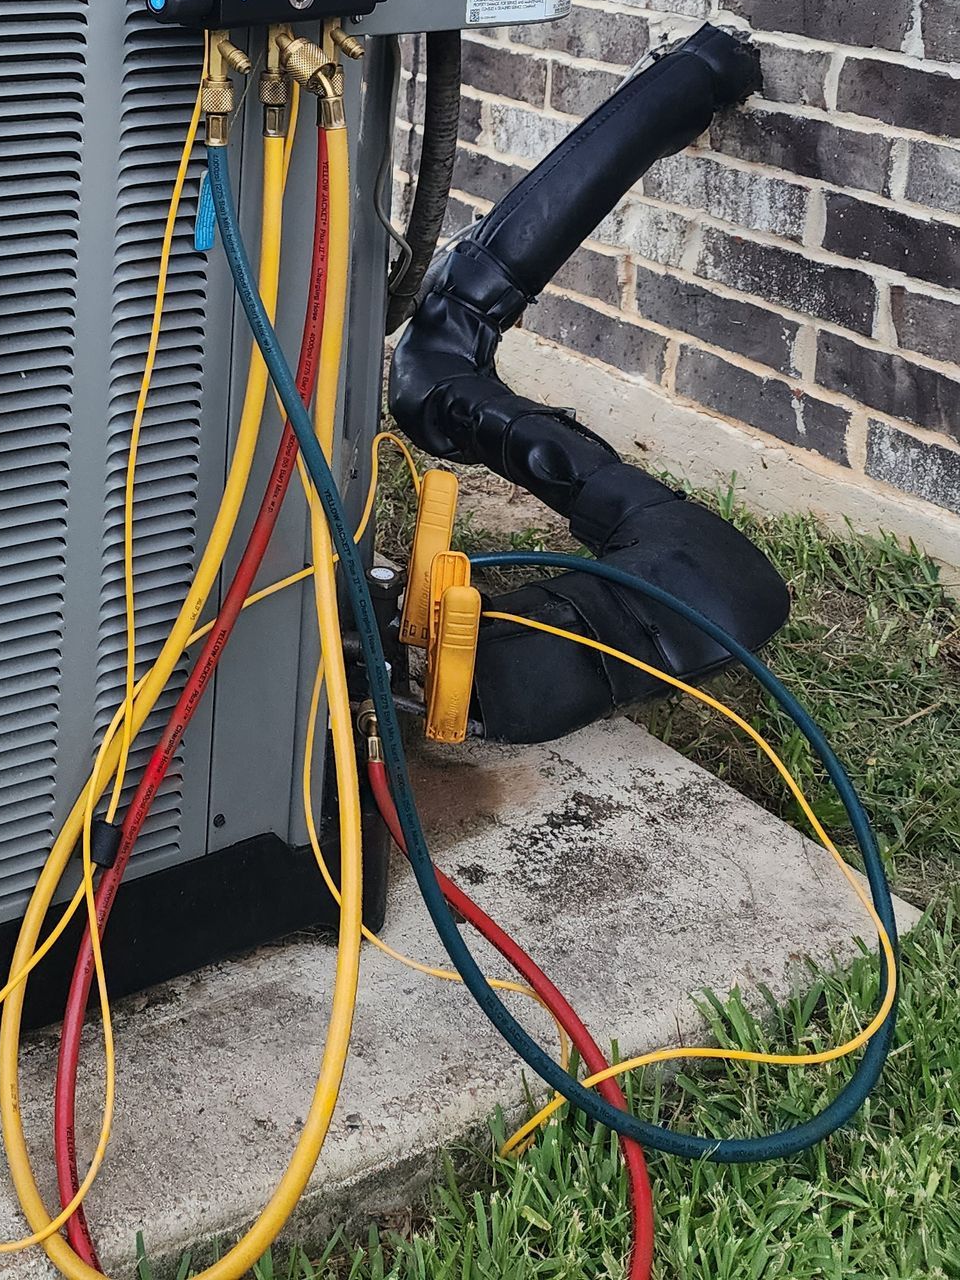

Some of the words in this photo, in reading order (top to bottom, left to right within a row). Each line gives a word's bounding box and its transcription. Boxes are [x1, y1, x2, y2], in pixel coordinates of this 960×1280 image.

[314, 268, 323, 301] Charging
[312, 303, 320, 320] Hose
[324, 488, 340, 520] YELLOW
[211, 629, 227, 658] YELLOW
[189, 689, 199, 704] Plus
[163, 724, 183, 757] Charging
[157, 756, 169, 774] Hose
[66, 1126, 75, 1163] YELLOW
